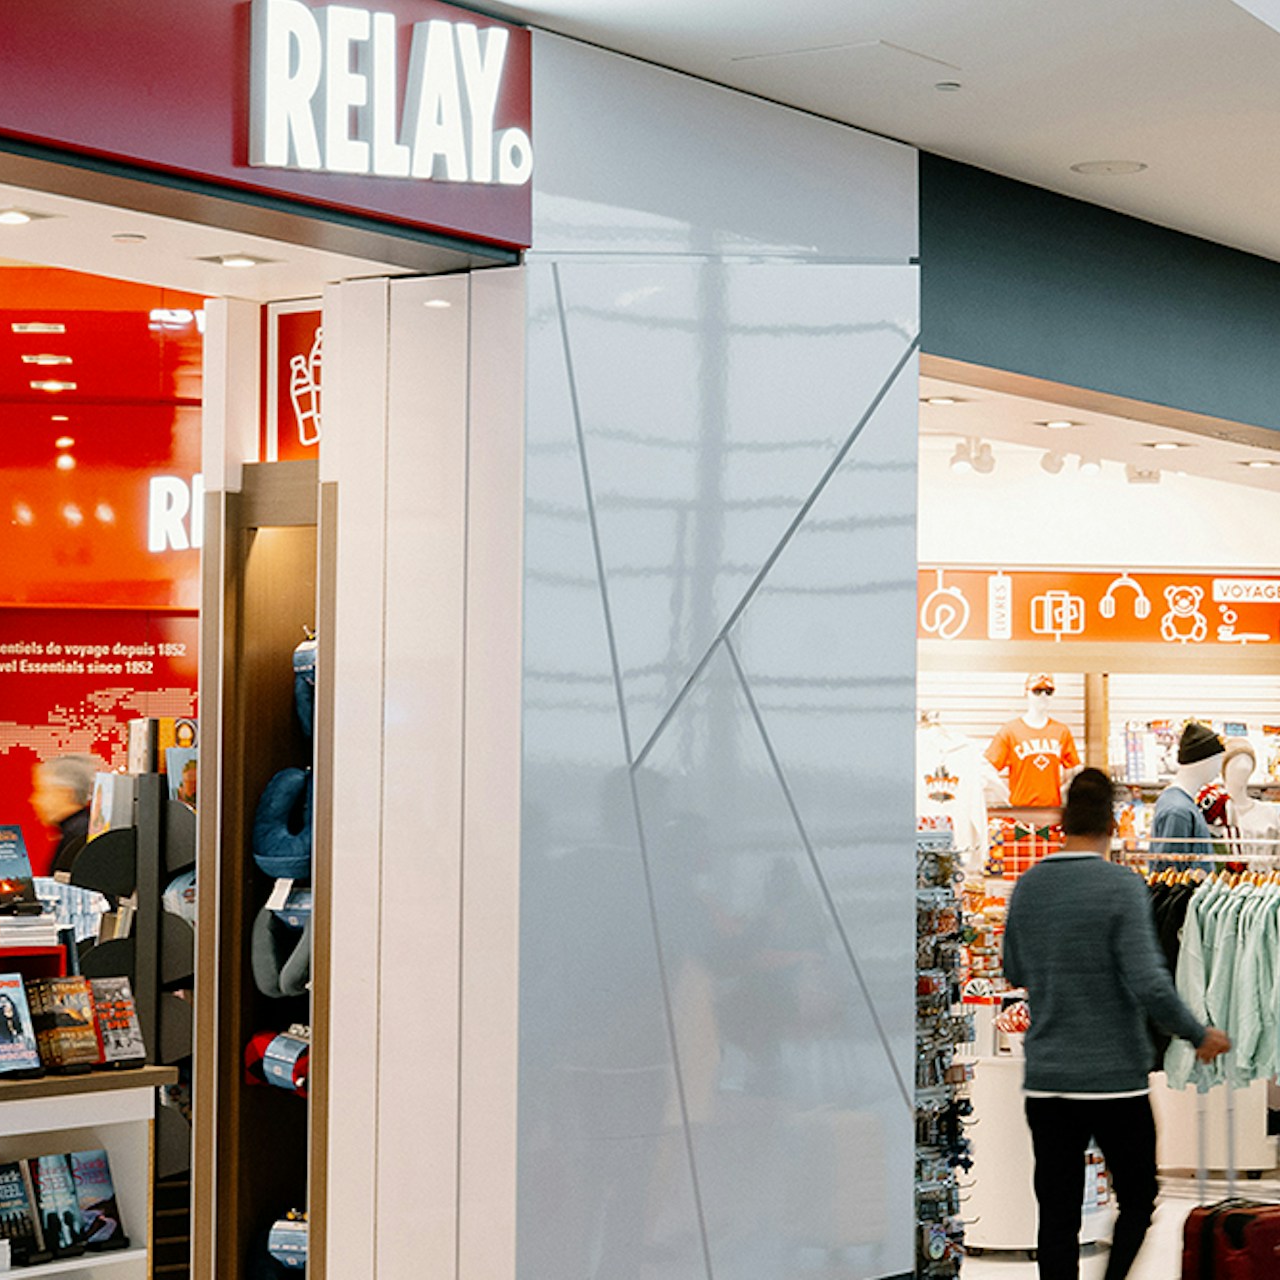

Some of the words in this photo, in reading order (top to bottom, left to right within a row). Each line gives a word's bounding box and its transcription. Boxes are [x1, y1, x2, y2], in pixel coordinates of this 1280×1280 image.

[46, 641, 61, 655] de
[64, 644, 109, 658] voyage
[113, 642, 155, 659] depuis
[158, 643, 187, 657] 1852
[20, 660, 84, 674] Essentials
[87, 661, 122, 674] since
[125, 661, 153, 674] 1852
